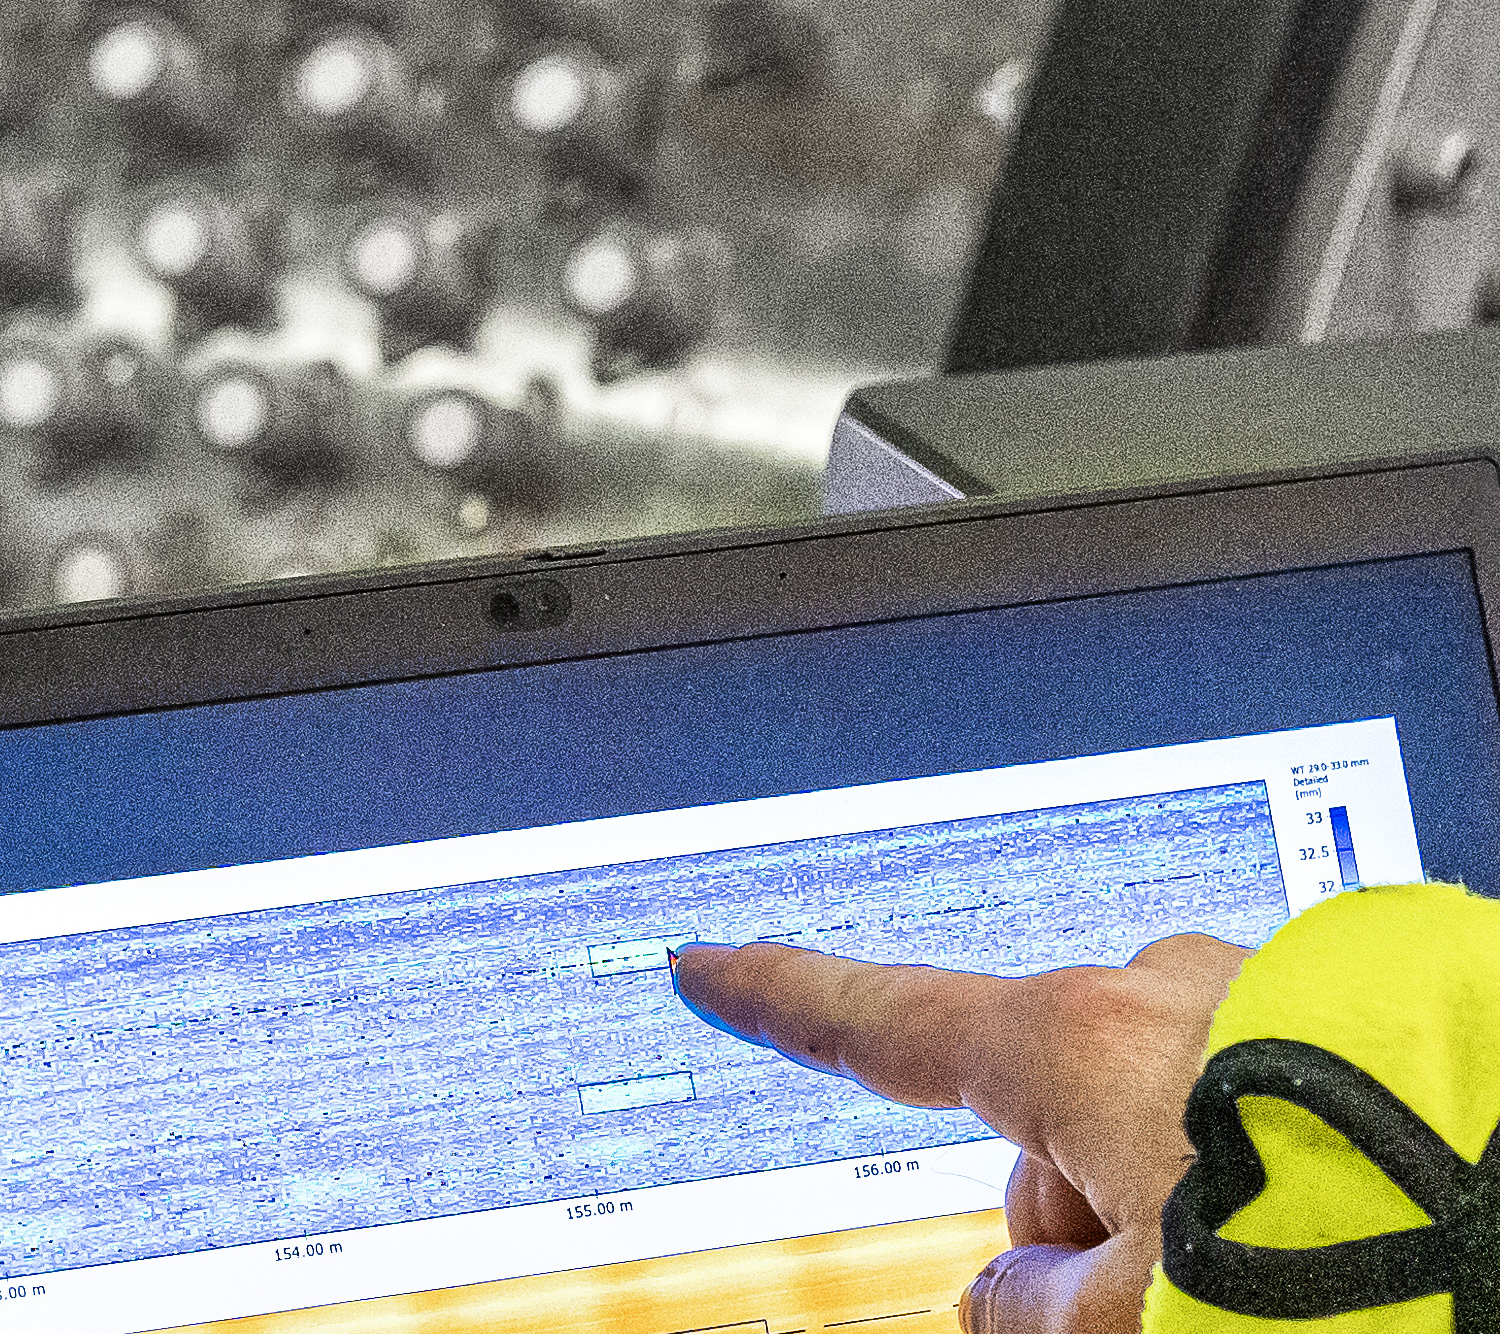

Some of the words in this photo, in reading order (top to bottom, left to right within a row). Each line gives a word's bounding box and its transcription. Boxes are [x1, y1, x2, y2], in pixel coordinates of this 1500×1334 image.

[1296, 787, 1322, 800] (mm)
[1307, 812, 1322, 824] 33
[1300, 846, 1329, 860] 32.5
[1319, 881, 1335, 893] 32
[855, 1161, 901, 1178] 156.00
[907, 1161, 919, 1170] m
[567, 1202, 614, 1219] 155.00
[620, 1202, 632, 1211] m
[276, 1243, 323, 1261] 154.00
[330, 1243, 342, 1253] m
[33, 1286, 45, 1295] m
